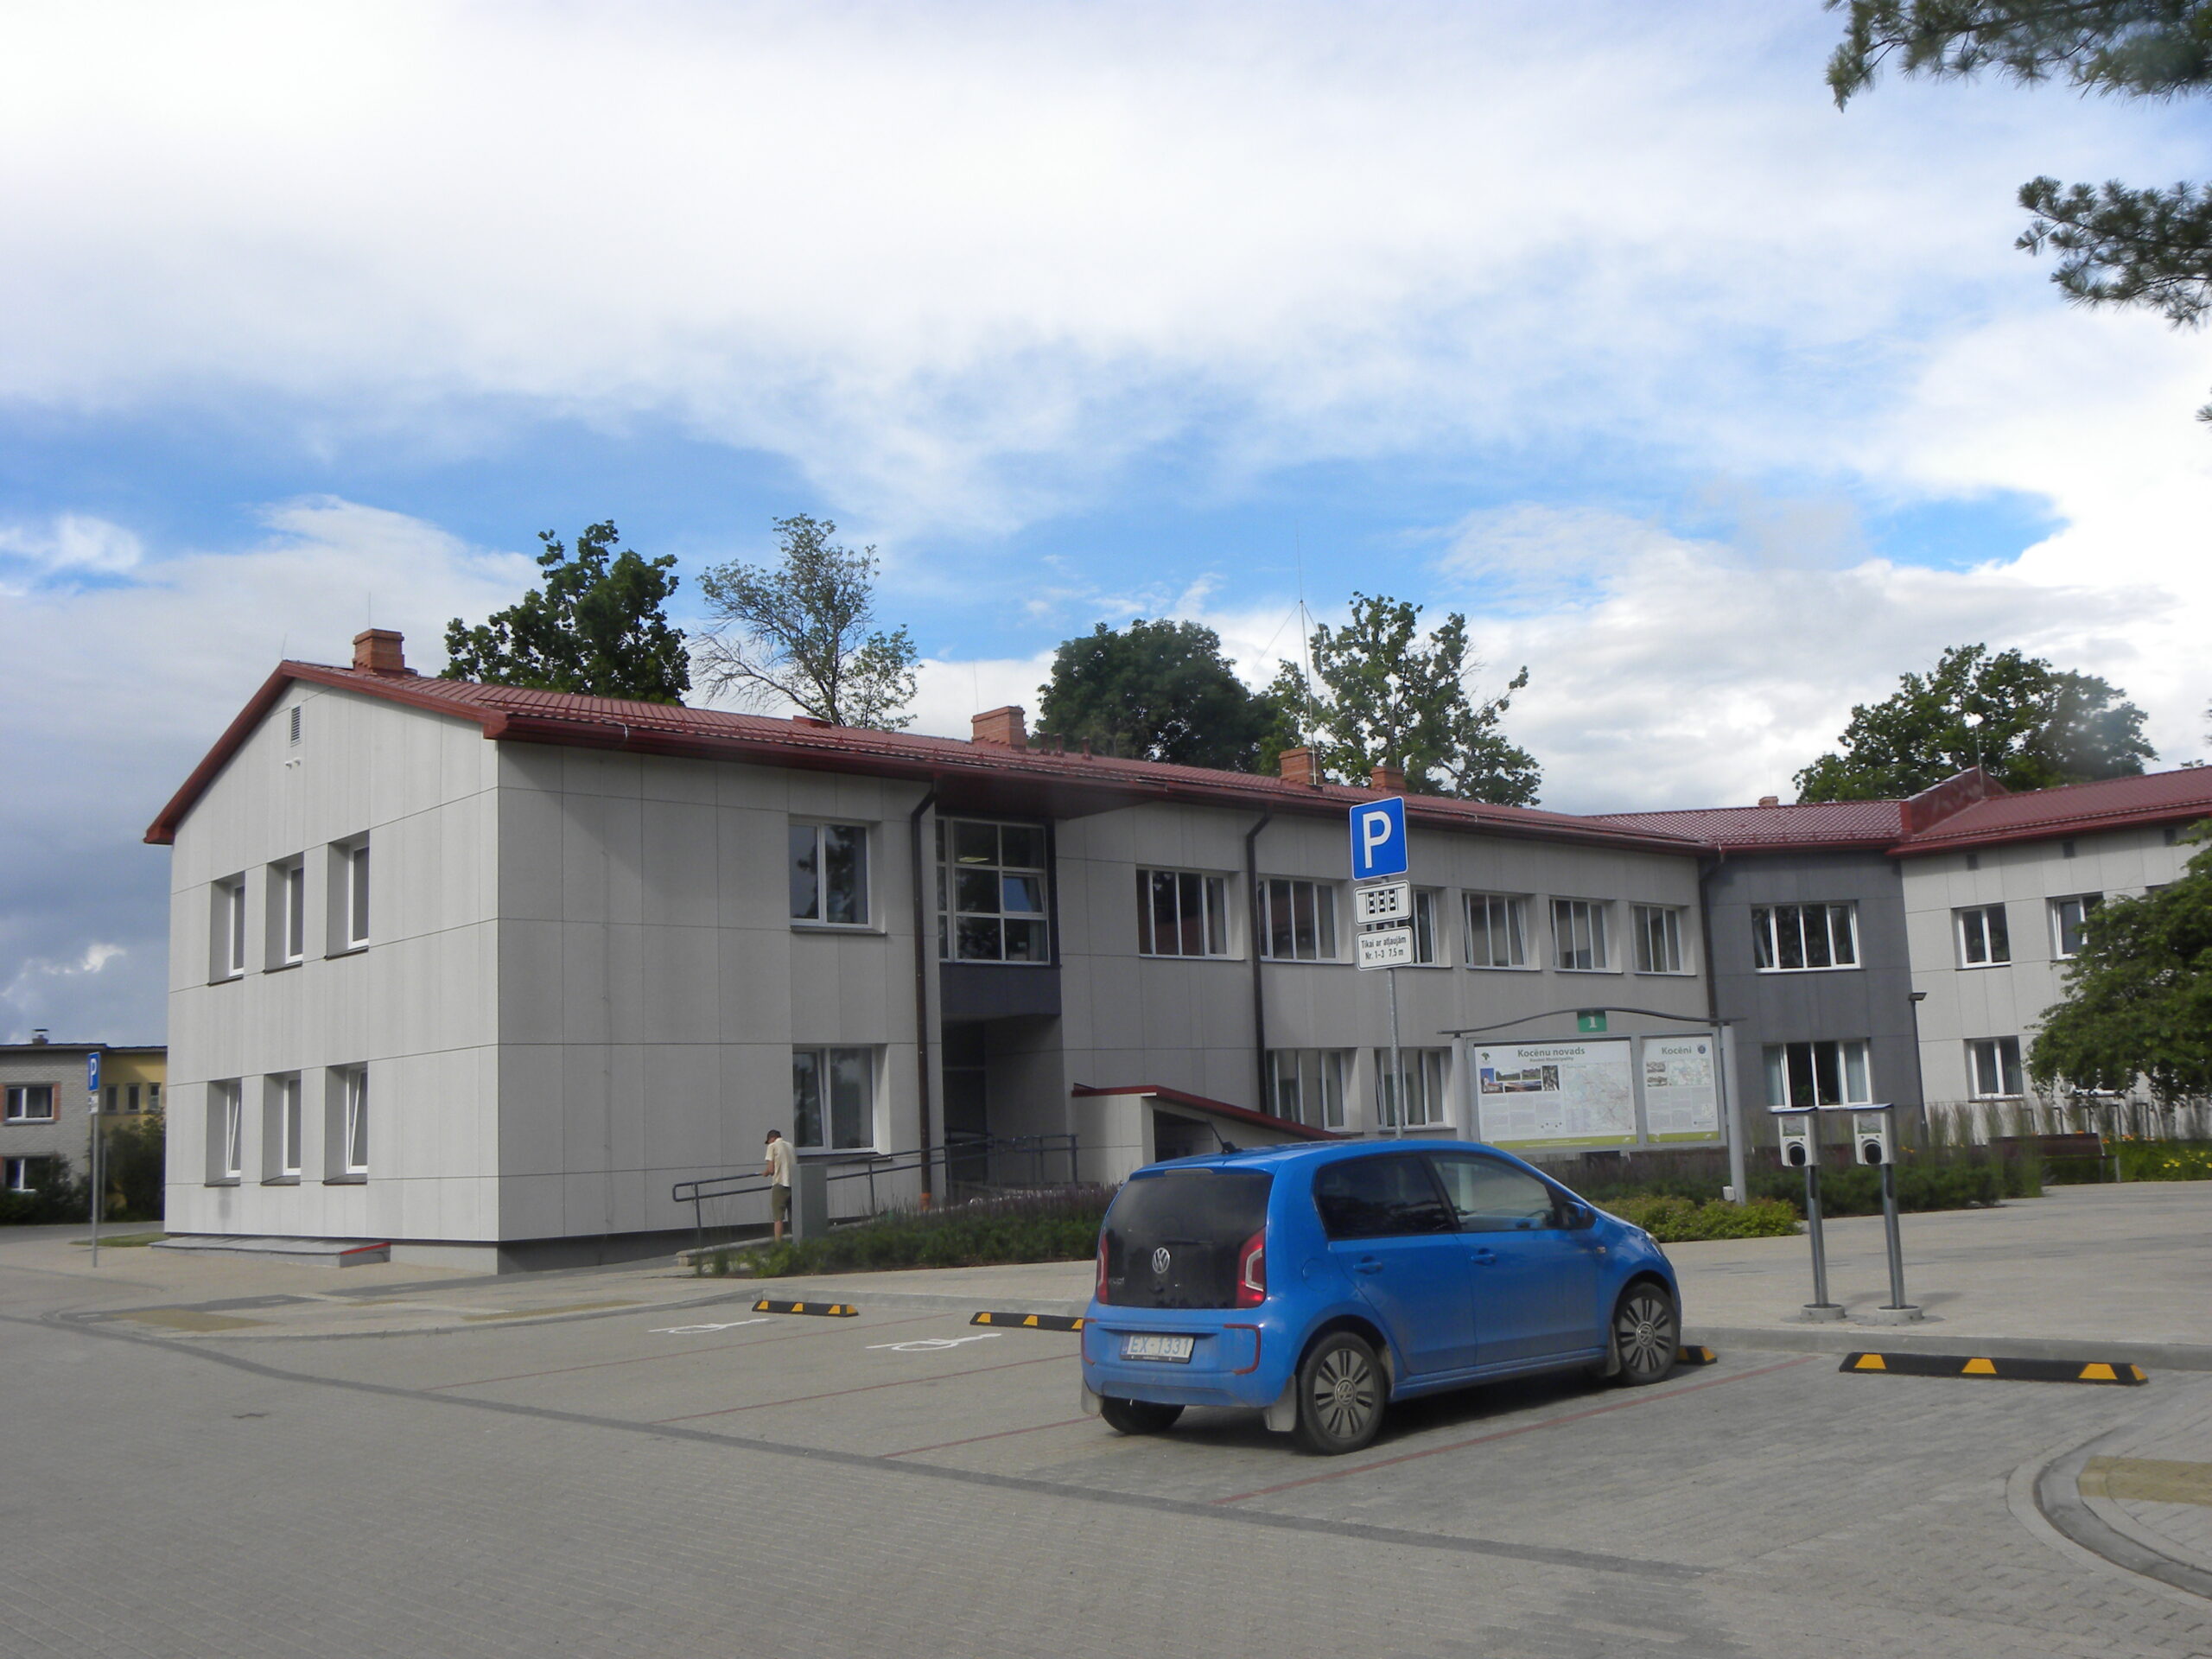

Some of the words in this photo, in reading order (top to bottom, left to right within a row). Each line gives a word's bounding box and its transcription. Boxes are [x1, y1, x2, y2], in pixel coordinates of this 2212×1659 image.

[1363, 810, 1391, 868] P
[1362, 940, 1374, 949] Tikai
[1365, 951, 1374, 960] Nr.
[1375, 950, 1384, 958] 1-3
[1553, 1047, 1586, 1056] novads
[90, 1058, 98, 1087] P
